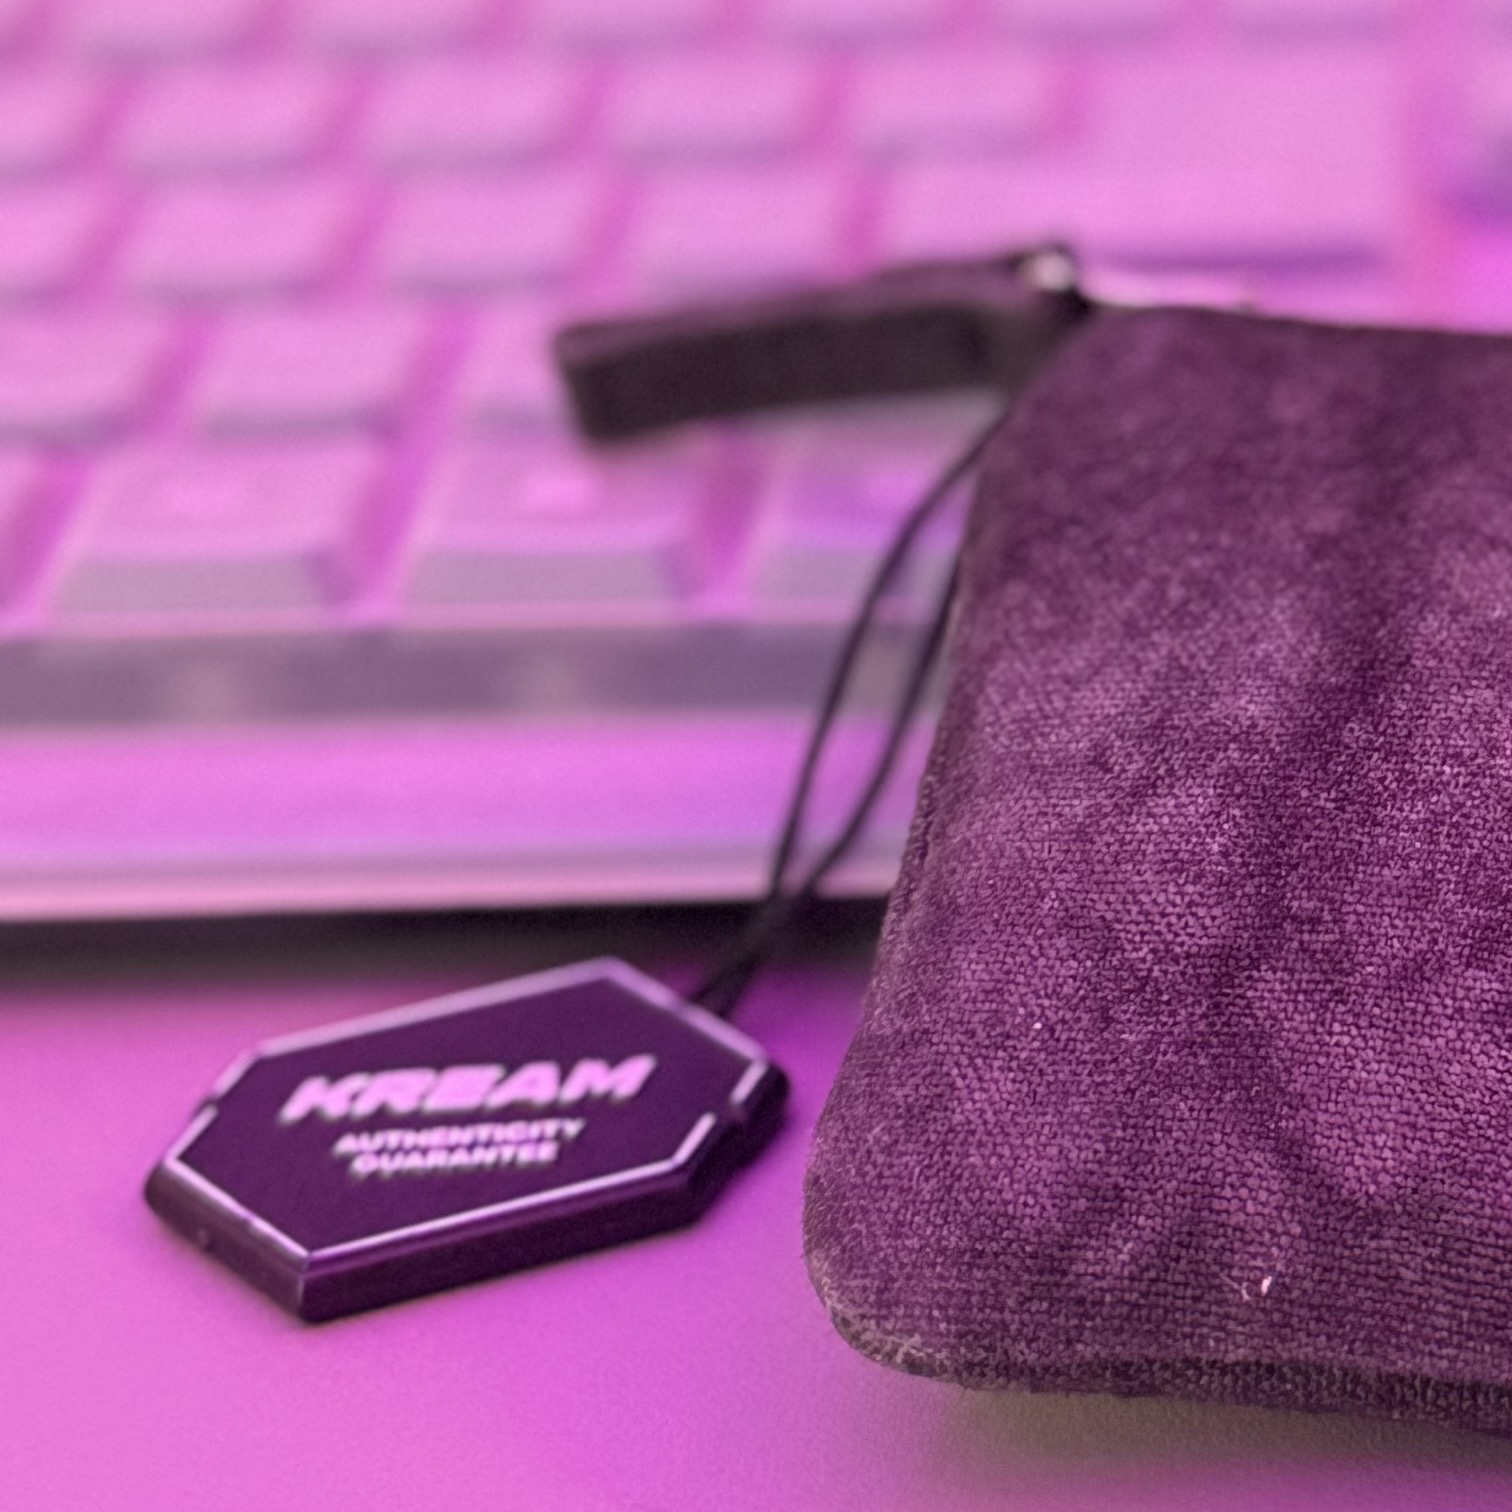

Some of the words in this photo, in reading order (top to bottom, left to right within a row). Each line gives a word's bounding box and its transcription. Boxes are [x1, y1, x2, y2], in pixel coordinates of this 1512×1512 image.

[280, 1054, 656, 1123] KREAM
[334, 1118, 585, 1156] AUTHENTICITY
[351, 1141, 560, 1175] GUARANTEE
